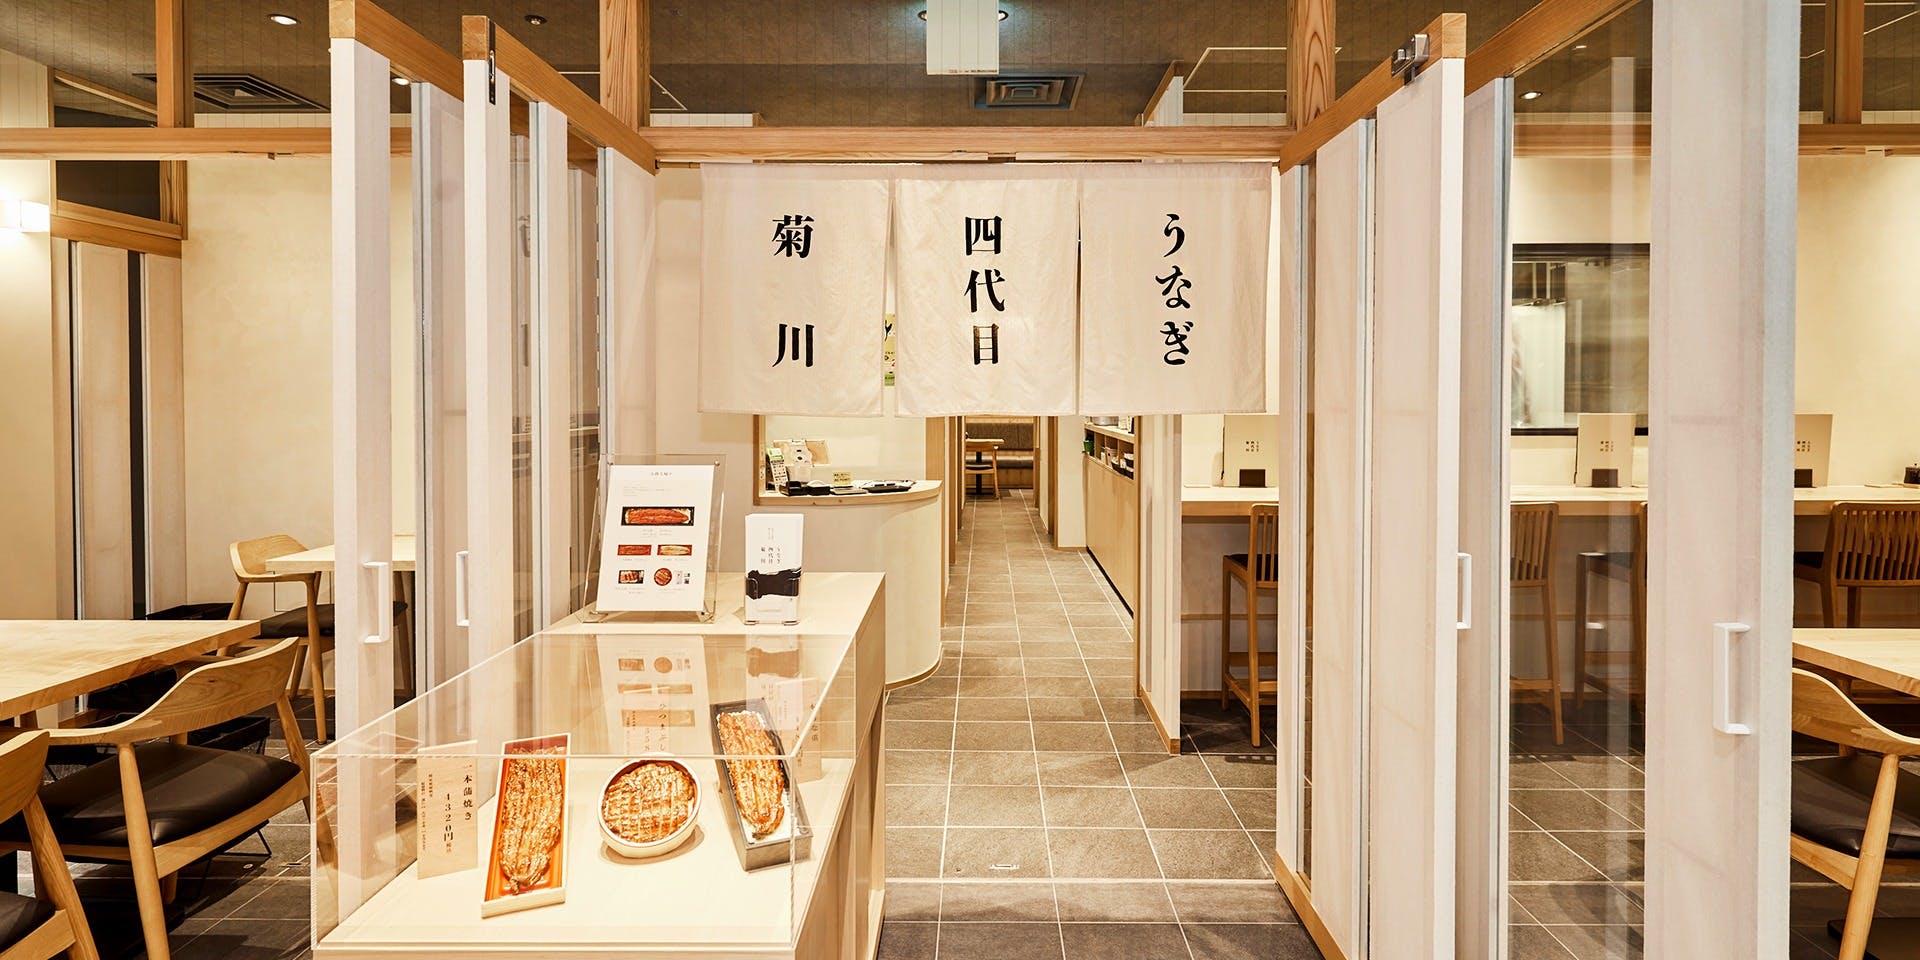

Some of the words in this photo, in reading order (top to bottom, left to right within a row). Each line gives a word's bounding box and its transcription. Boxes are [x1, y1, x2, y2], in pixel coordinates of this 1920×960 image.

[772, 215, 814, 367] 菊川
[965, 216, 1005, 365] 四代目
[1156, 214, 1193, 365] うなぎ
